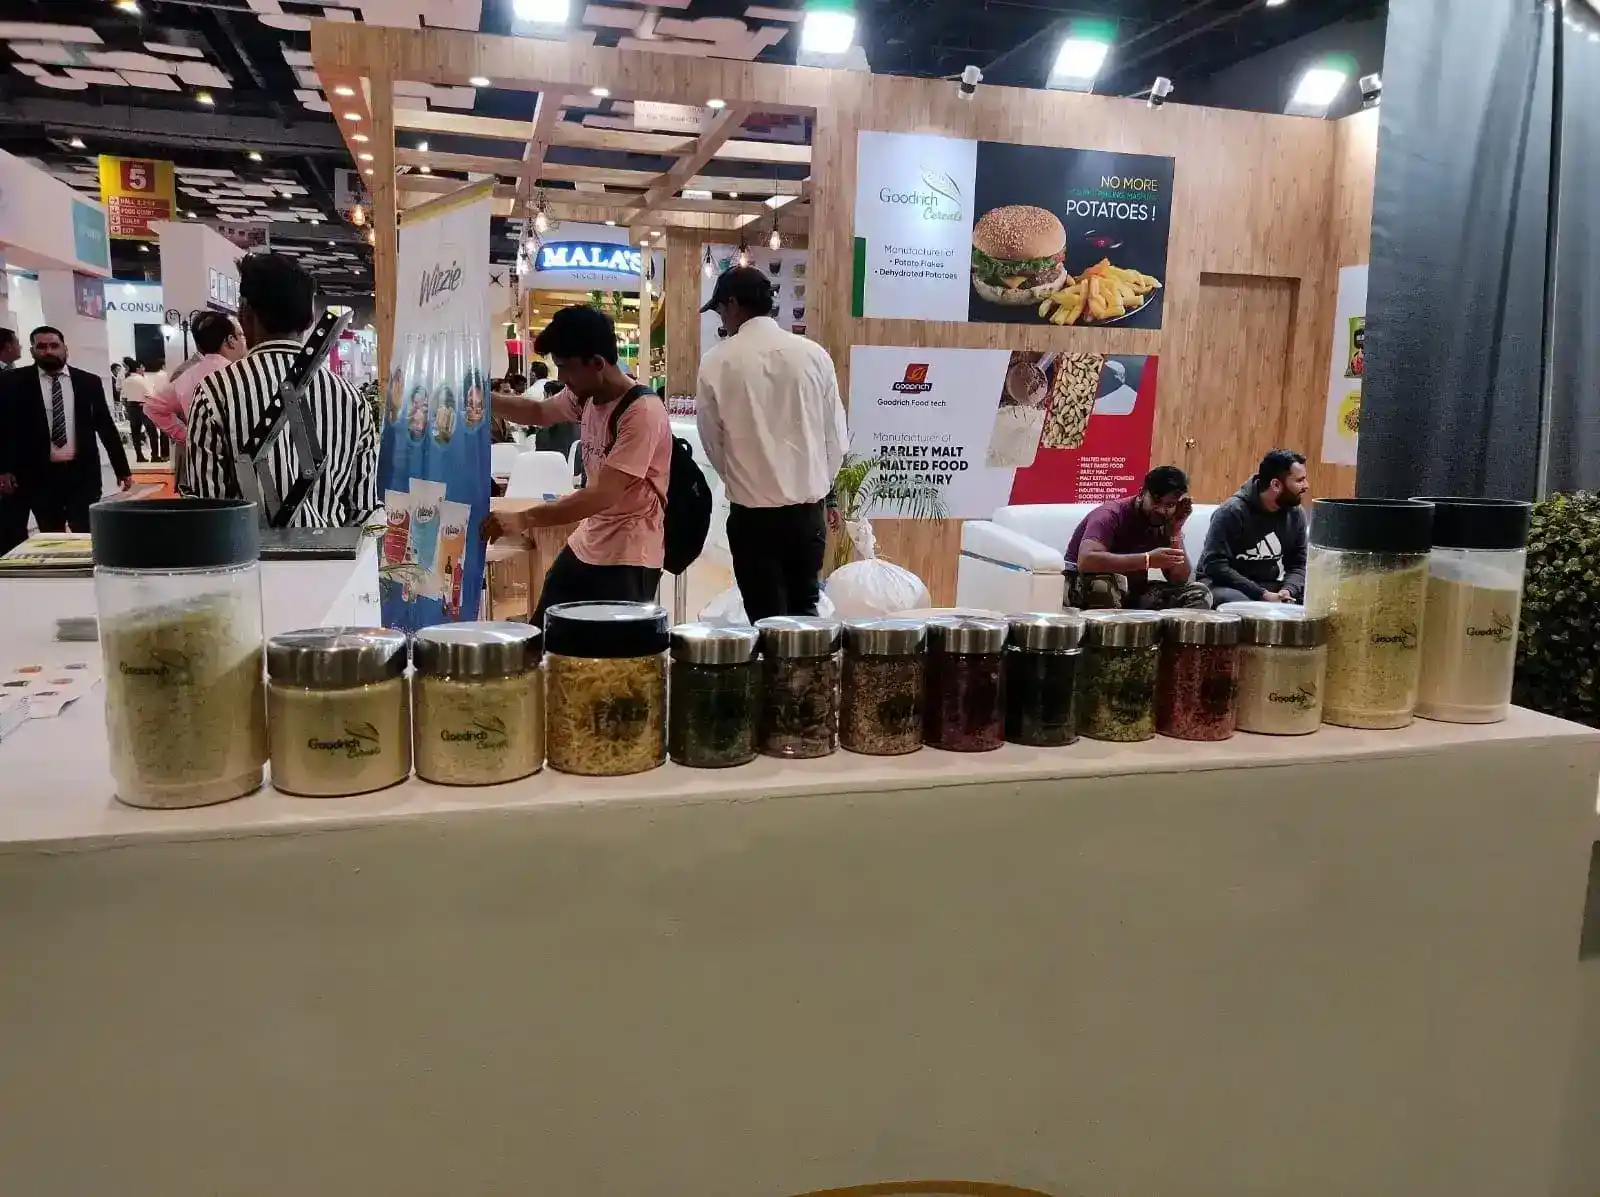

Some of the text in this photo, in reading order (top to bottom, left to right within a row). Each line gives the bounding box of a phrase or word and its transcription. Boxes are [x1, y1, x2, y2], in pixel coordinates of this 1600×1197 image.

[129, 168, 147, 190] 5
[1101, 175, 1158, 192] NO MORE
[879, 187, 938, 206] Goodrich
[1066, 200, 1148, 221] POTATOES
[884, 244, 956, 257] Manufacturer of
[894, 258, 944, 269] Potato Flakes
[879, 268, 958, 280] Dehydrated Potatoes
[877, 398, 909, 406] Goodrich
[873, 432, 951, 442] Manufacturer of
[880, 446, 964, 457] BARLEY MALT
[880, 460, 969, 471] MALTED FOOD
